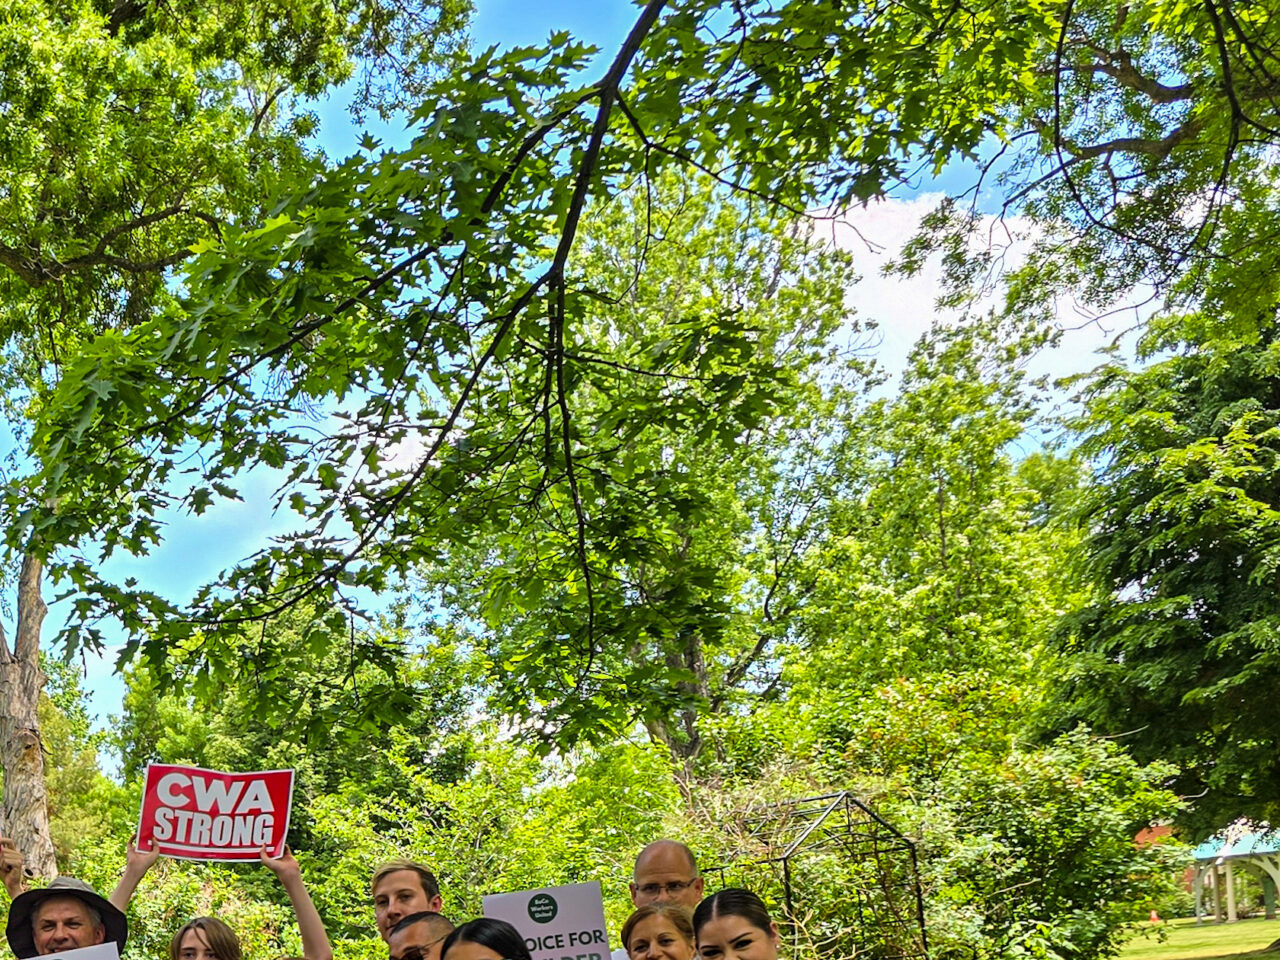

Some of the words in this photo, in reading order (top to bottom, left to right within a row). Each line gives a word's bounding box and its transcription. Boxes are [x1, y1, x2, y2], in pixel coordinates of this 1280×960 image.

[157, 772, 275, 814] CWA
[153, 807, 275, 847] STRONG
[524, 934, 565, 952] OICE
[568, 929, 606, 947] FOR
